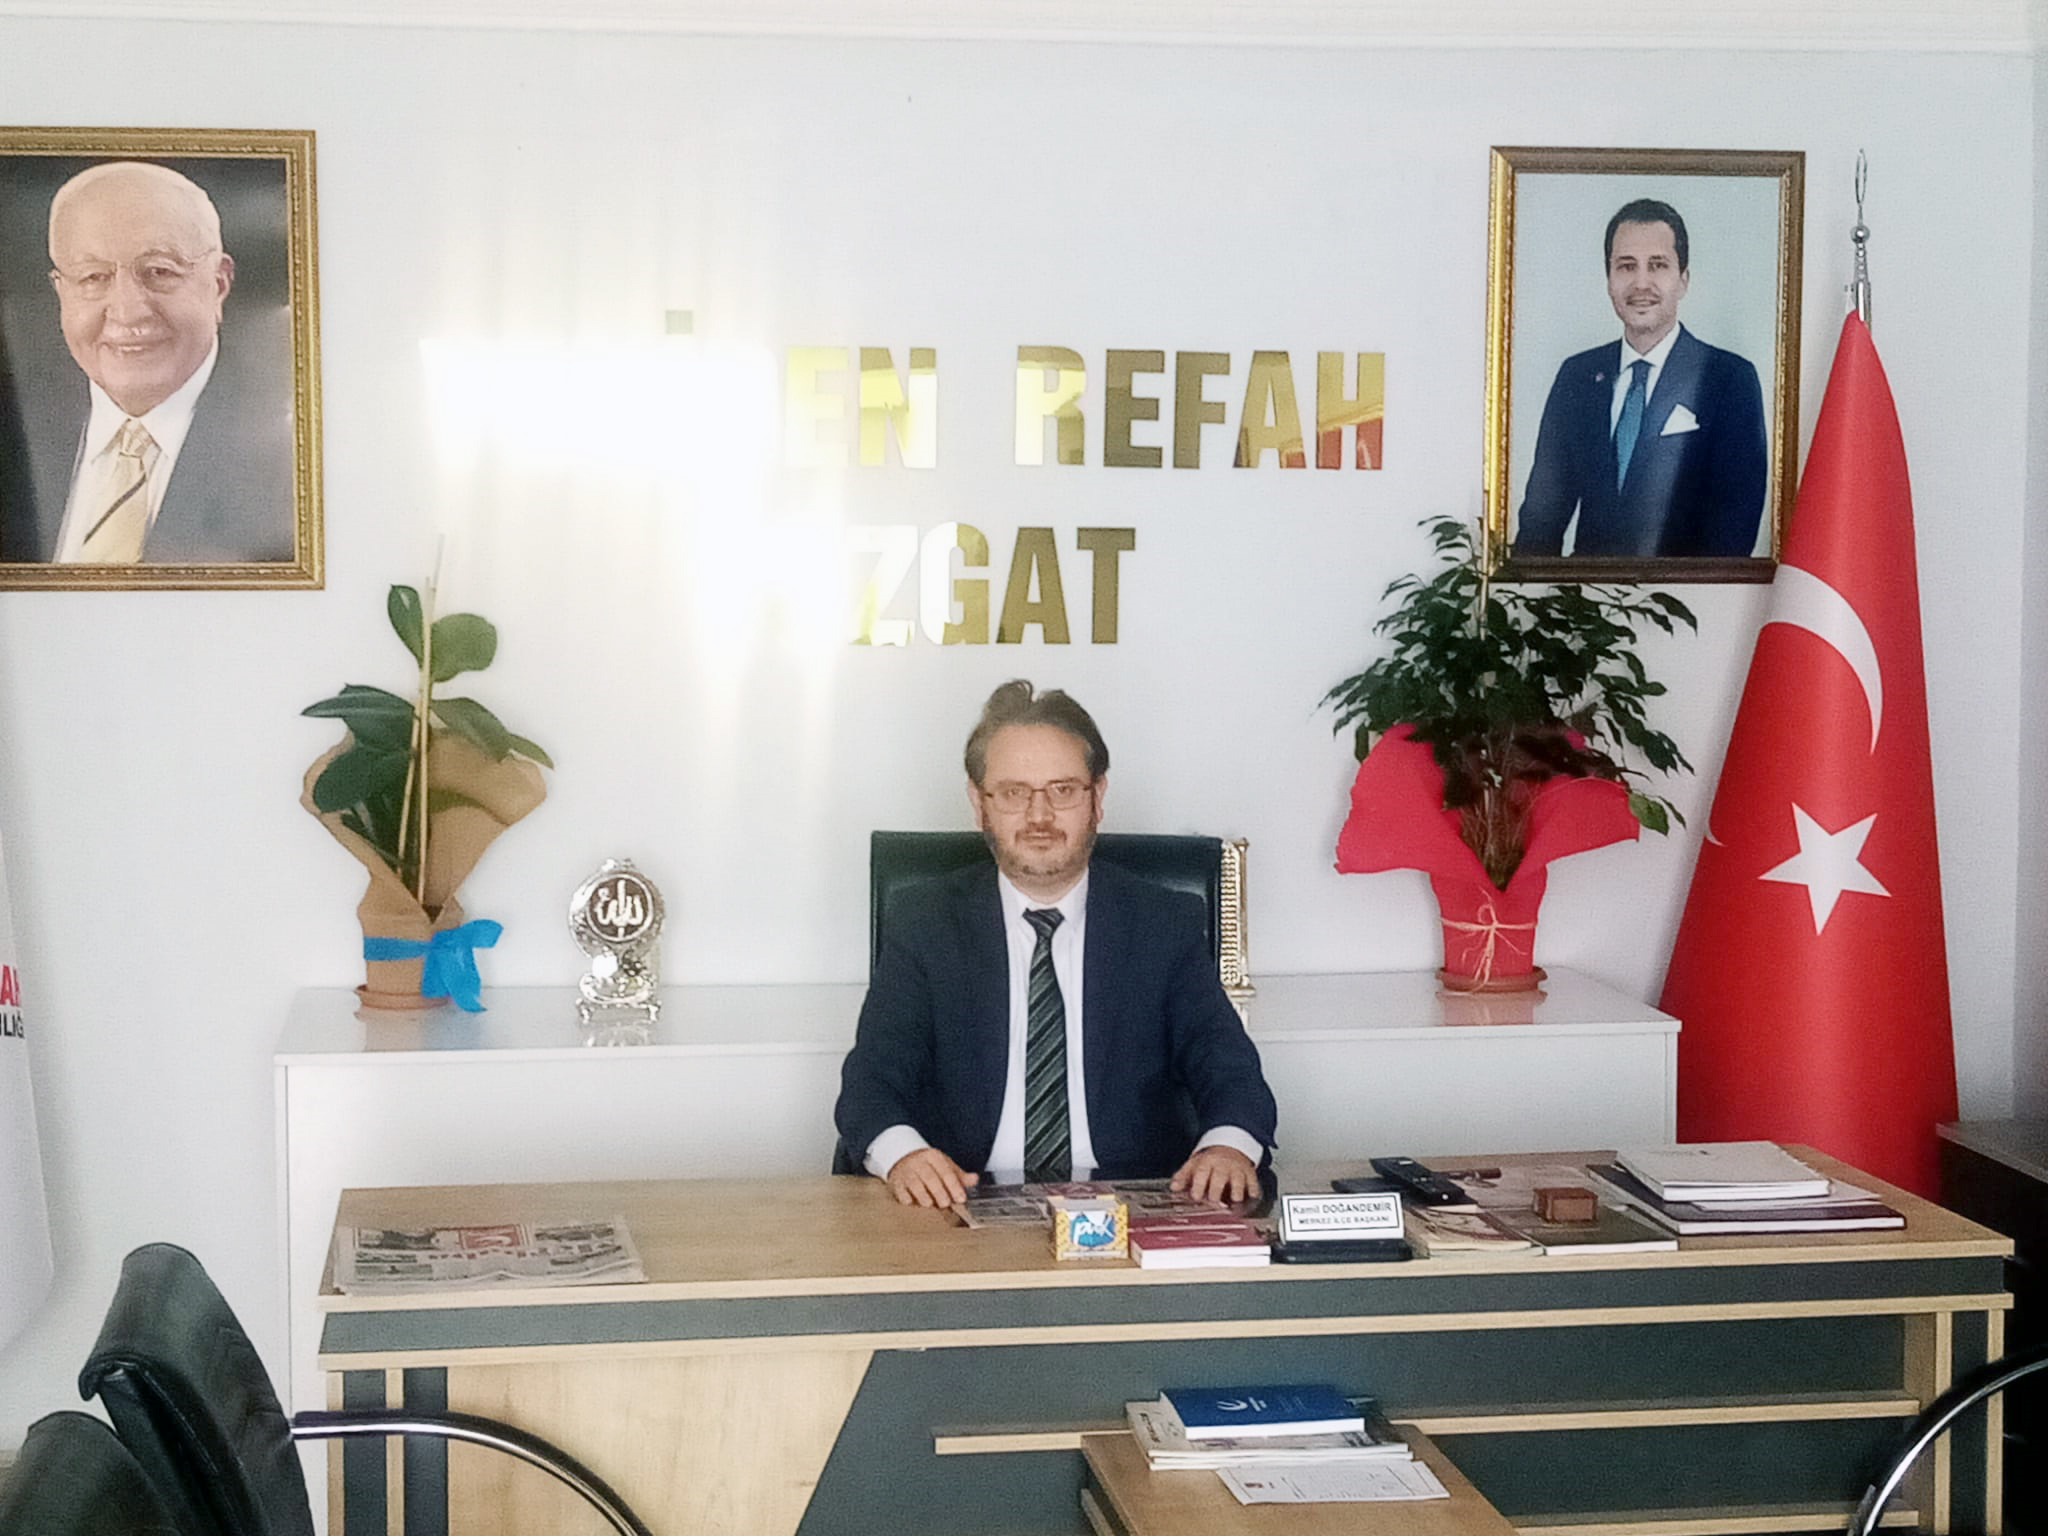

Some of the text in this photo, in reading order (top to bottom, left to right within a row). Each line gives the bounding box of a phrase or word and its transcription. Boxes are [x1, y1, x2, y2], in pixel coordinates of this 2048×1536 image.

[1015, 345, 1385, 470] REFAH
[848, 522, 1136, 645] ZGAT
[1293, 1202, 1392, 1214] Kamil DOĞANDEMİR
